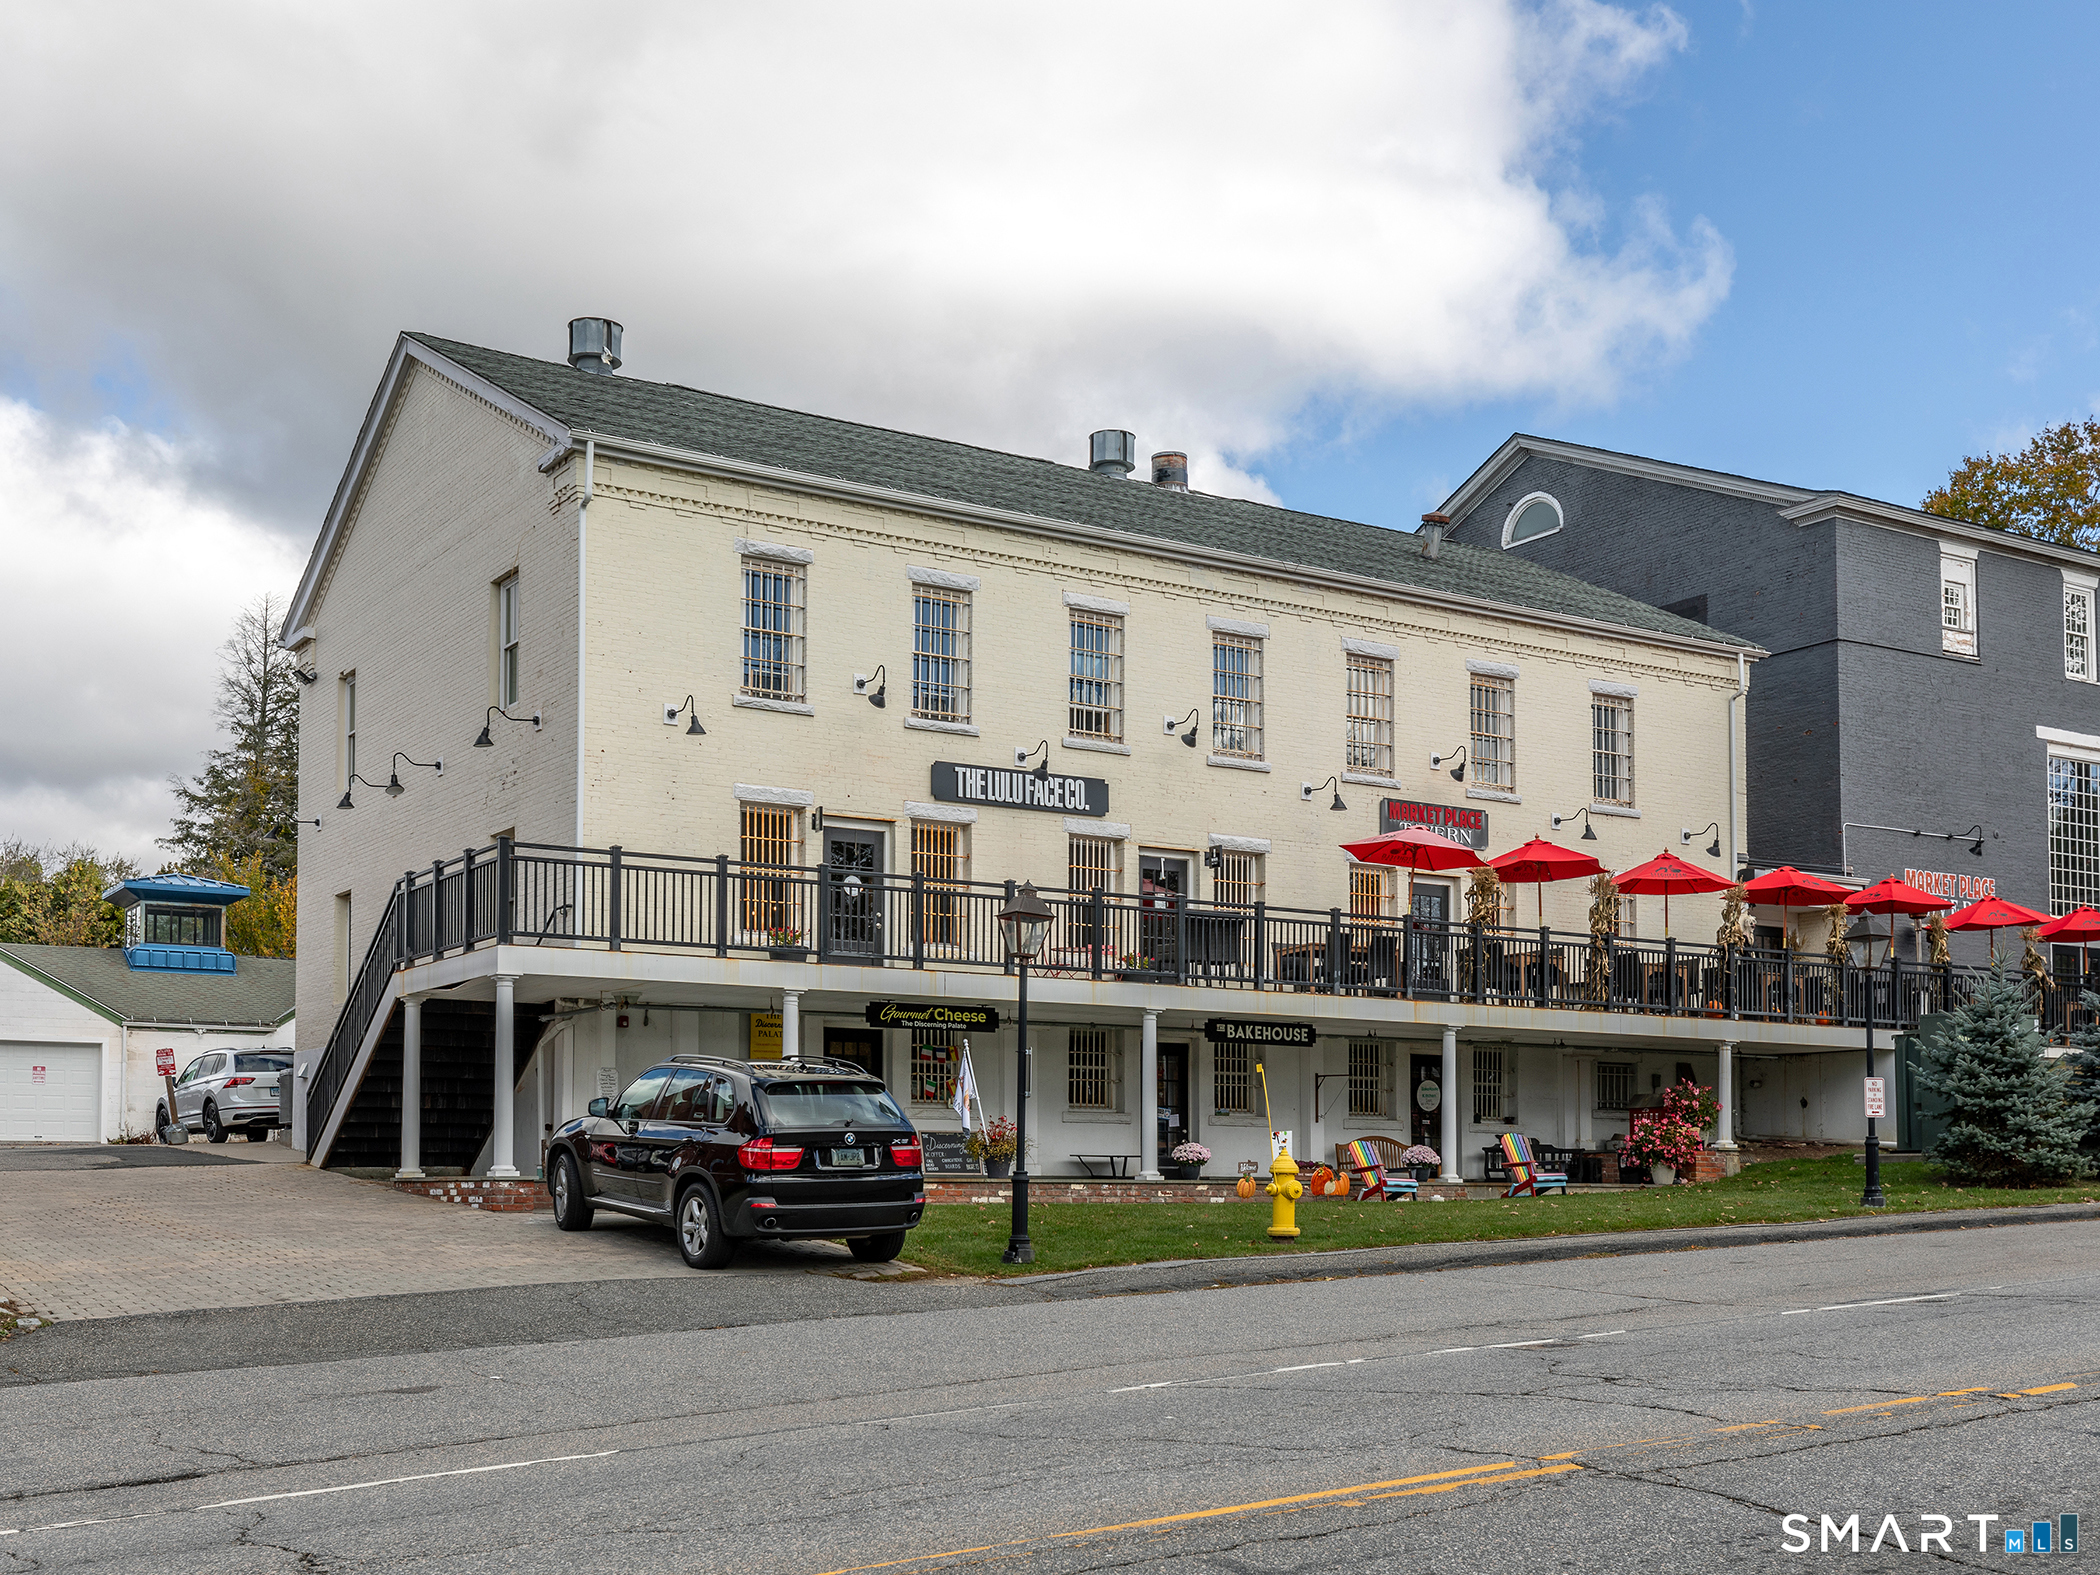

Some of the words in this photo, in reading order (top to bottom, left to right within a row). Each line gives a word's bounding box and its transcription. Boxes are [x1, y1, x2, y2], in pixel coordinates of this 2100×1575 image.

[954, 766, 986, 799] THE
[987, 770, 1023, 804] LULU
[1025, 774, 1064, 808] FACE
[1064, 779, 1090, 811] CO.
[1389, 801, 1442, 825] MARKET
[1445, 807, 1482, 830] PLACE
[1399, 821, 1473, 845] TERN
[1904, 868, 1957, 897] MARKET
[1959, 875, 1996, 899] PLACE
[880, 1003, 934, 1023] Gourmet
[934, 1007, 987, 1023] Cheese
[755, 1018, 783, 1029] Discern
[914, 1021, 947, 1030] Discerning
[1227, 1024, 1309, 1042] BAKEHOUSE
[758, 1030, 783, 1038] PALAT
